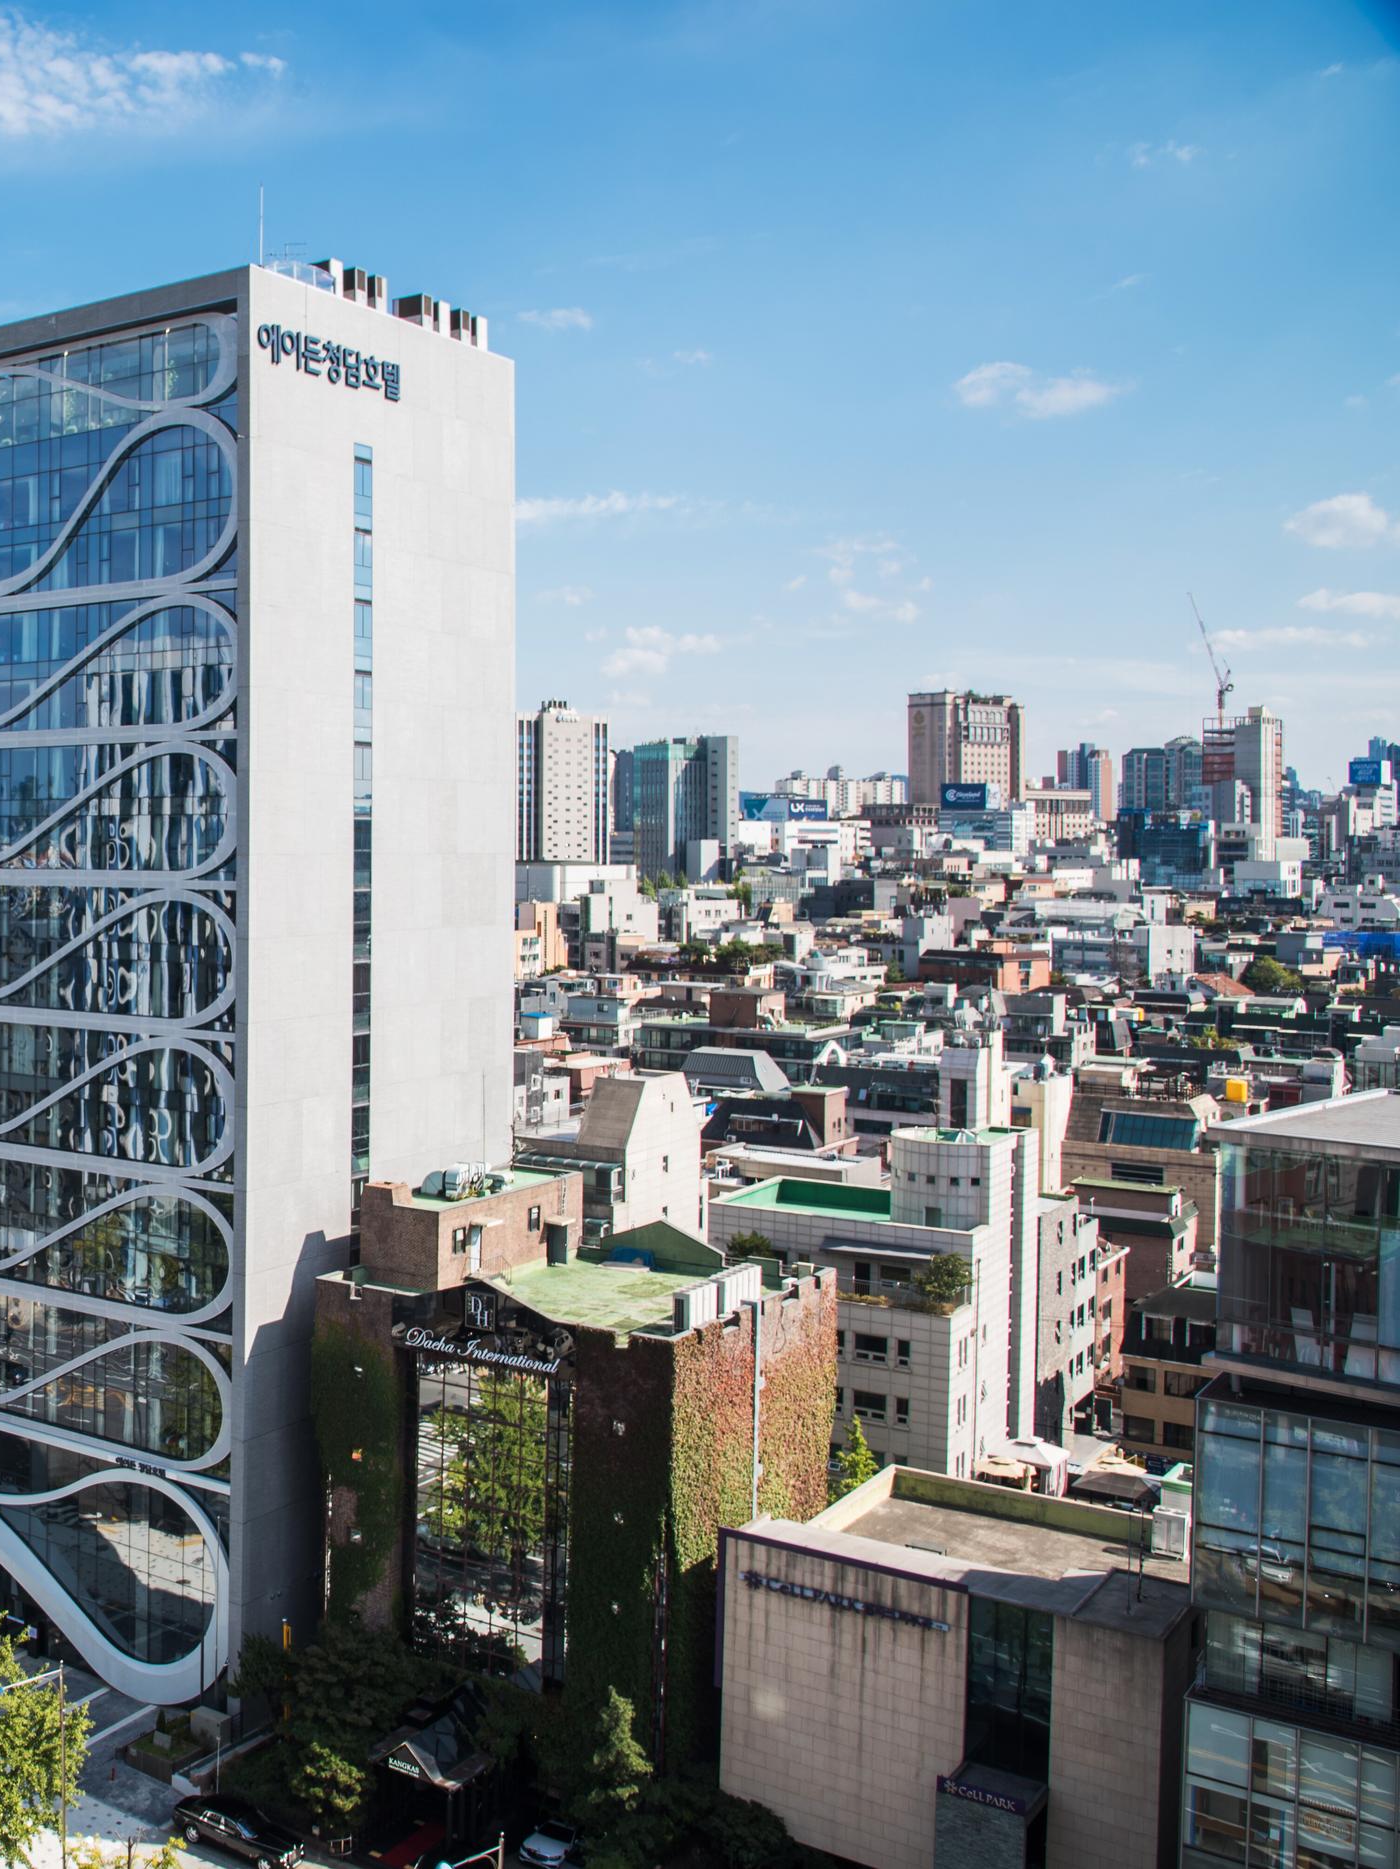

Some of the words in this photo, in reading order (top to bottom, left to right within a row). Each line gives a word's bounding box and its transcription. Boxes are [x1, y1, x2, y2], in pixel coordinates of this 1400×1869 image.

[257, 323, 400, 403] 에이든청담호텔
[405, 1327, 455, 1353] Daeha
[457, 1339, 561, 1374] International
